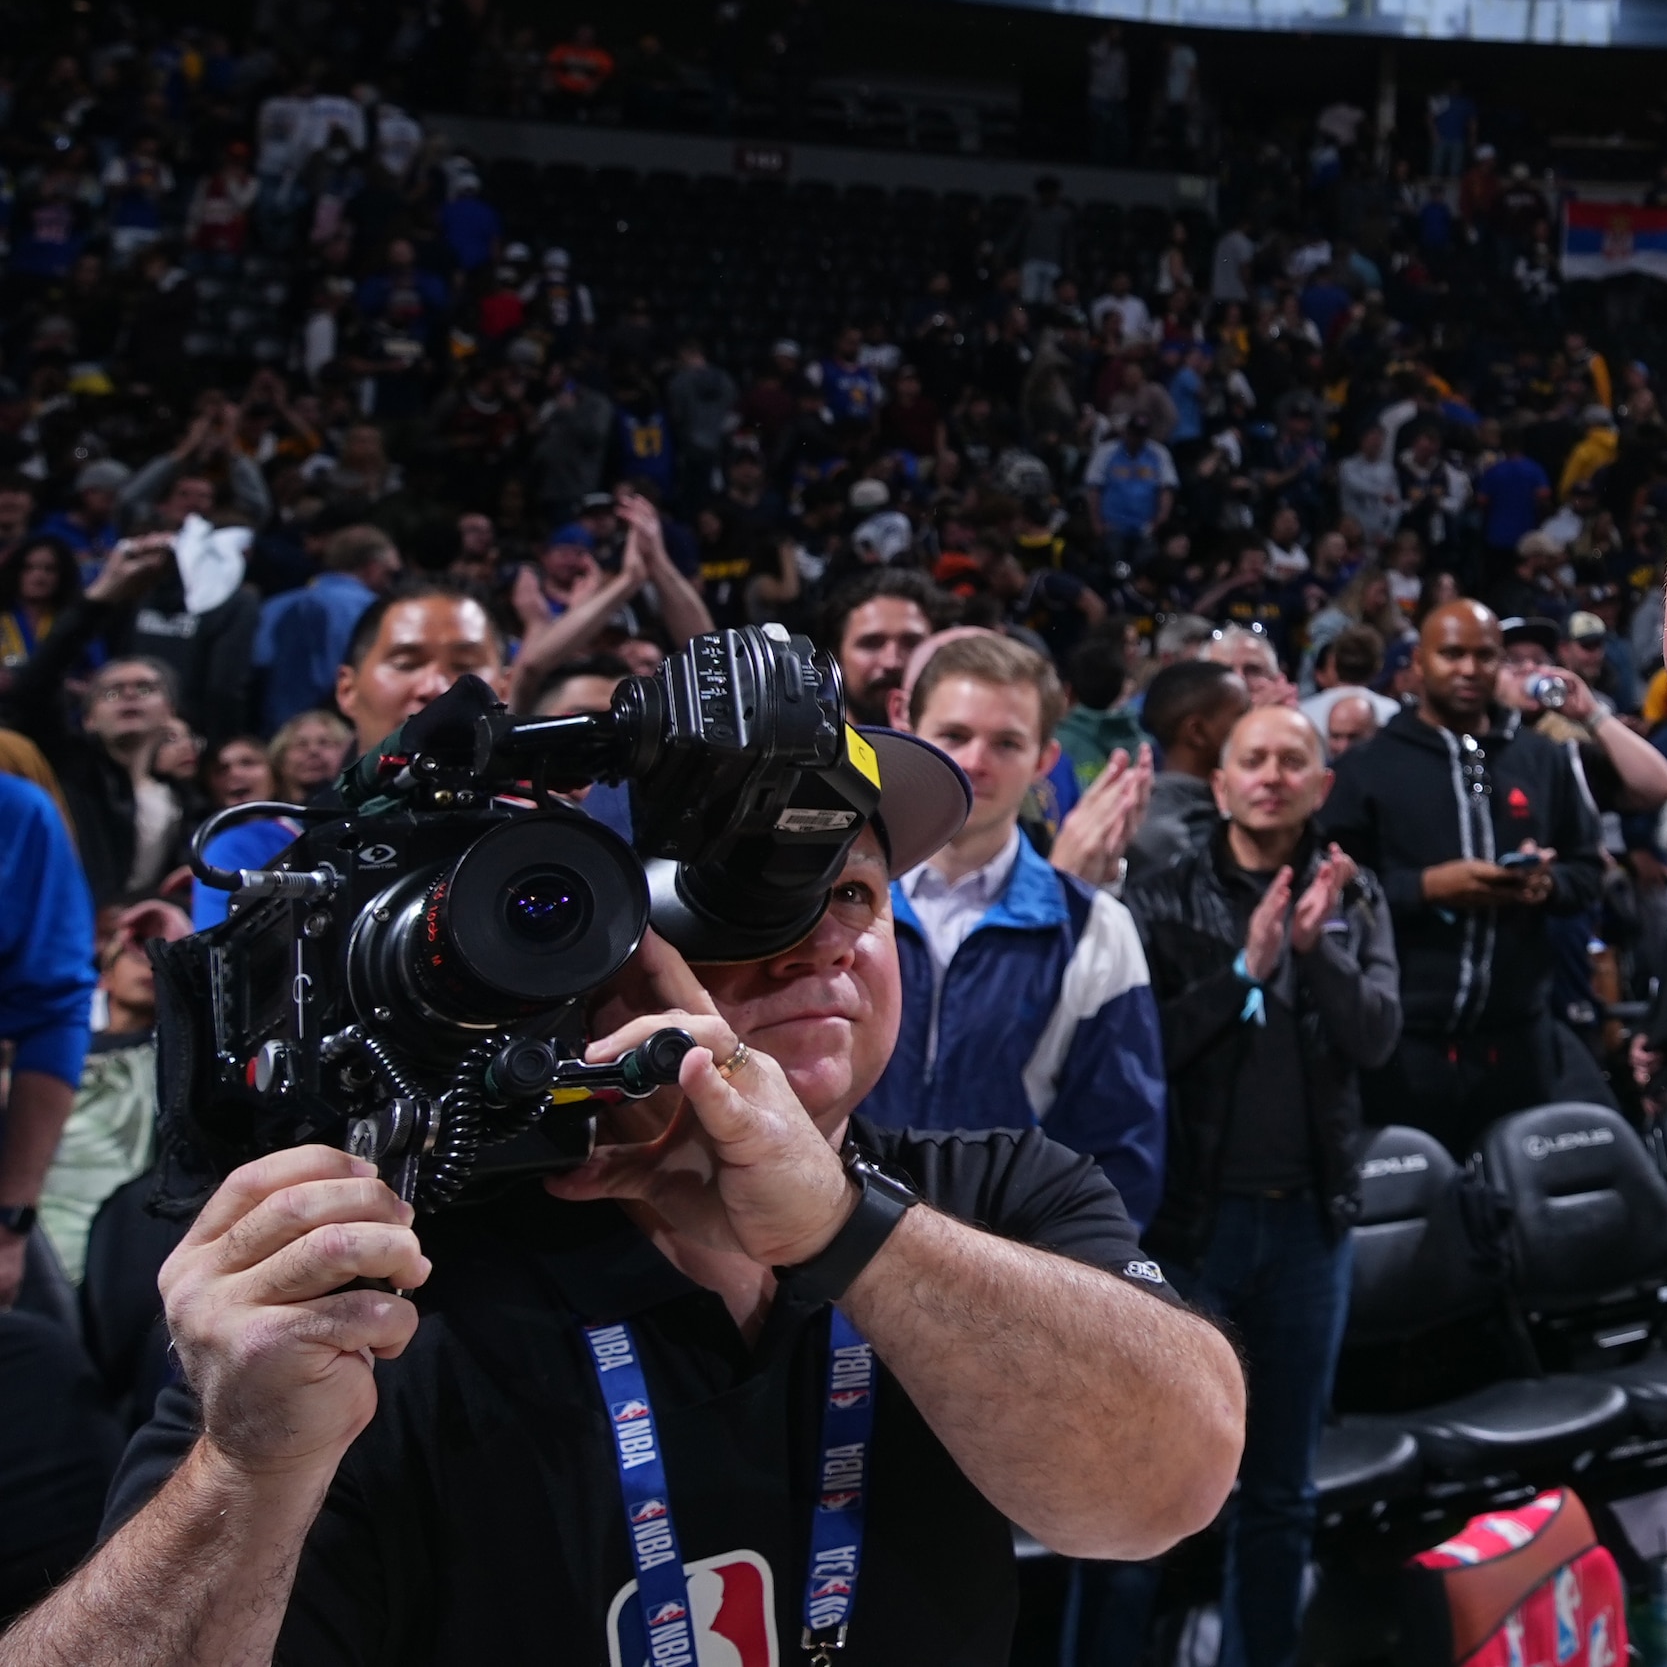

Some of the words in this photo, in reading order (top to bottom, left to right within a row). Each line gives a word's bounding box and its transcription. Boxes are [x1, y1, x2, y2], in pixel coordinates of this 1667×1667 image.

[588, 1323, 634, 1373] NBA
[832, 1342, 873, 1391] NBA
[615, 1417, 657, 1471] NBA
[823, 1441, 866, 1492] NBA
[632, 1516, 677, 1573] NBA
